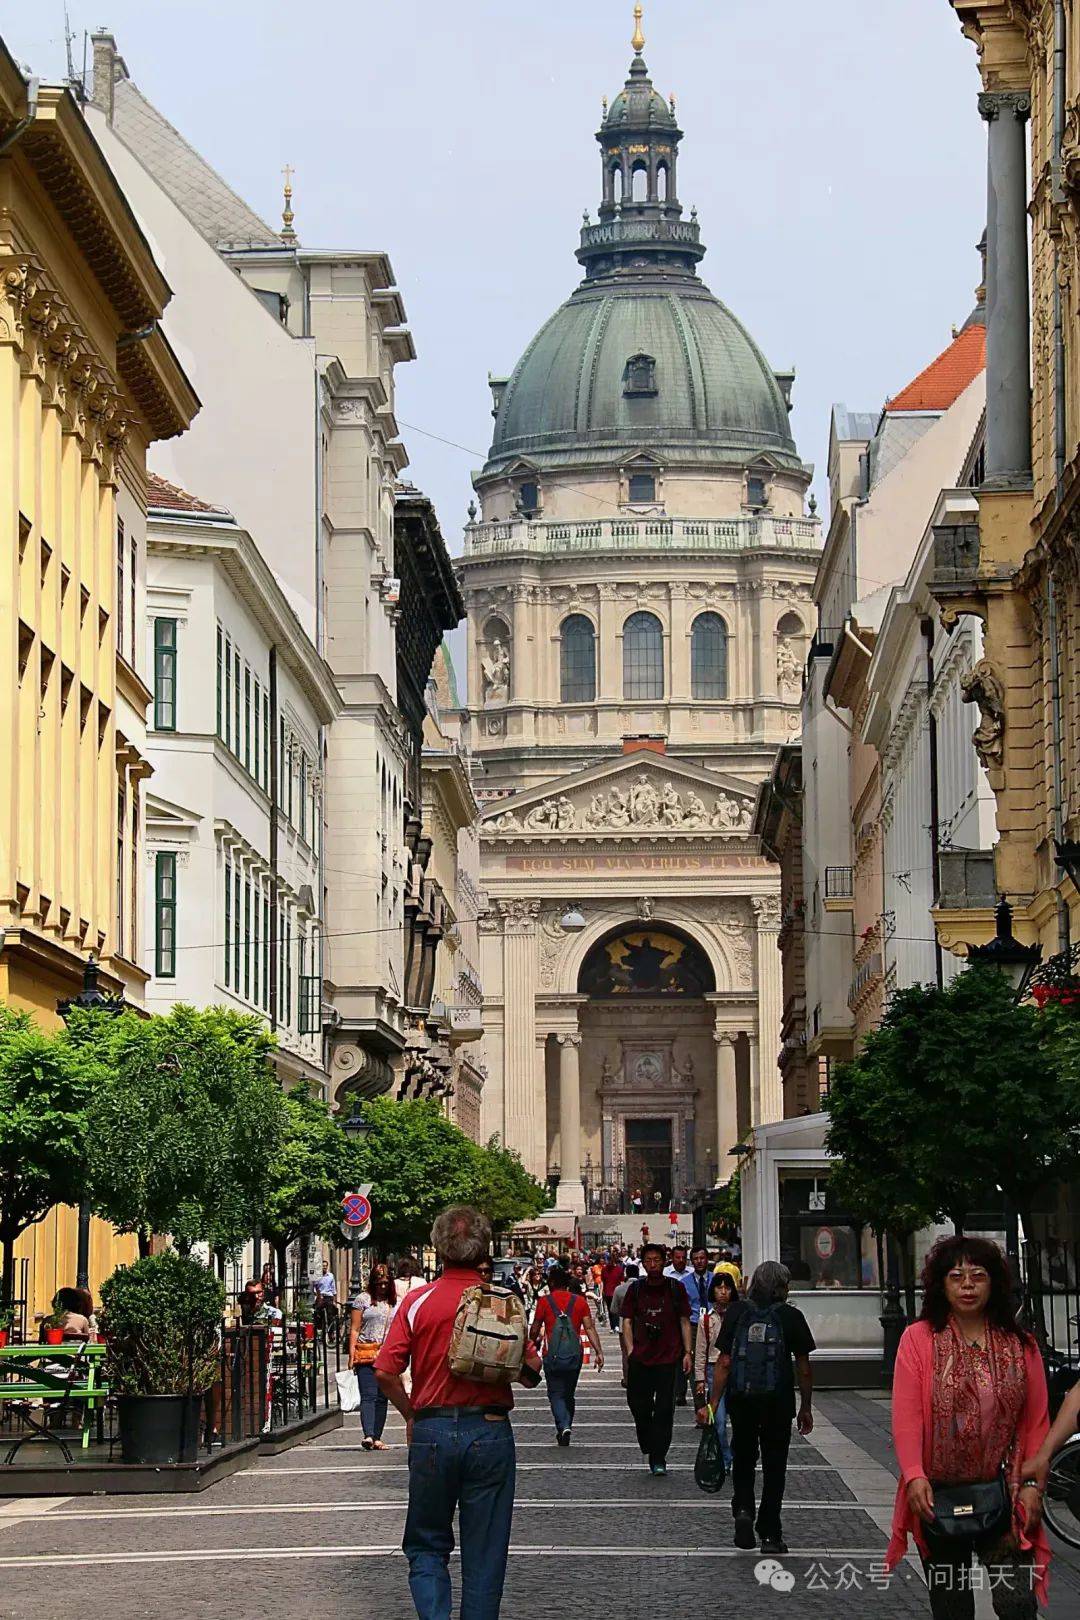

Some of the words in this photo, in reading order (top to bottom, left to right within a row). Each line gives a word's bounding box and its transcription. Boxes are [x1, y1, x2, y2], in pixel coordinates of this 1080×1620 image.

[522, 859, 552, 871] EGO
[562, 858, 596, 871] SUM
[606, 858, 632, 870] VIA
[640, 857, 701, 869] VERITAS
[710, 856, 726, 868] ET
